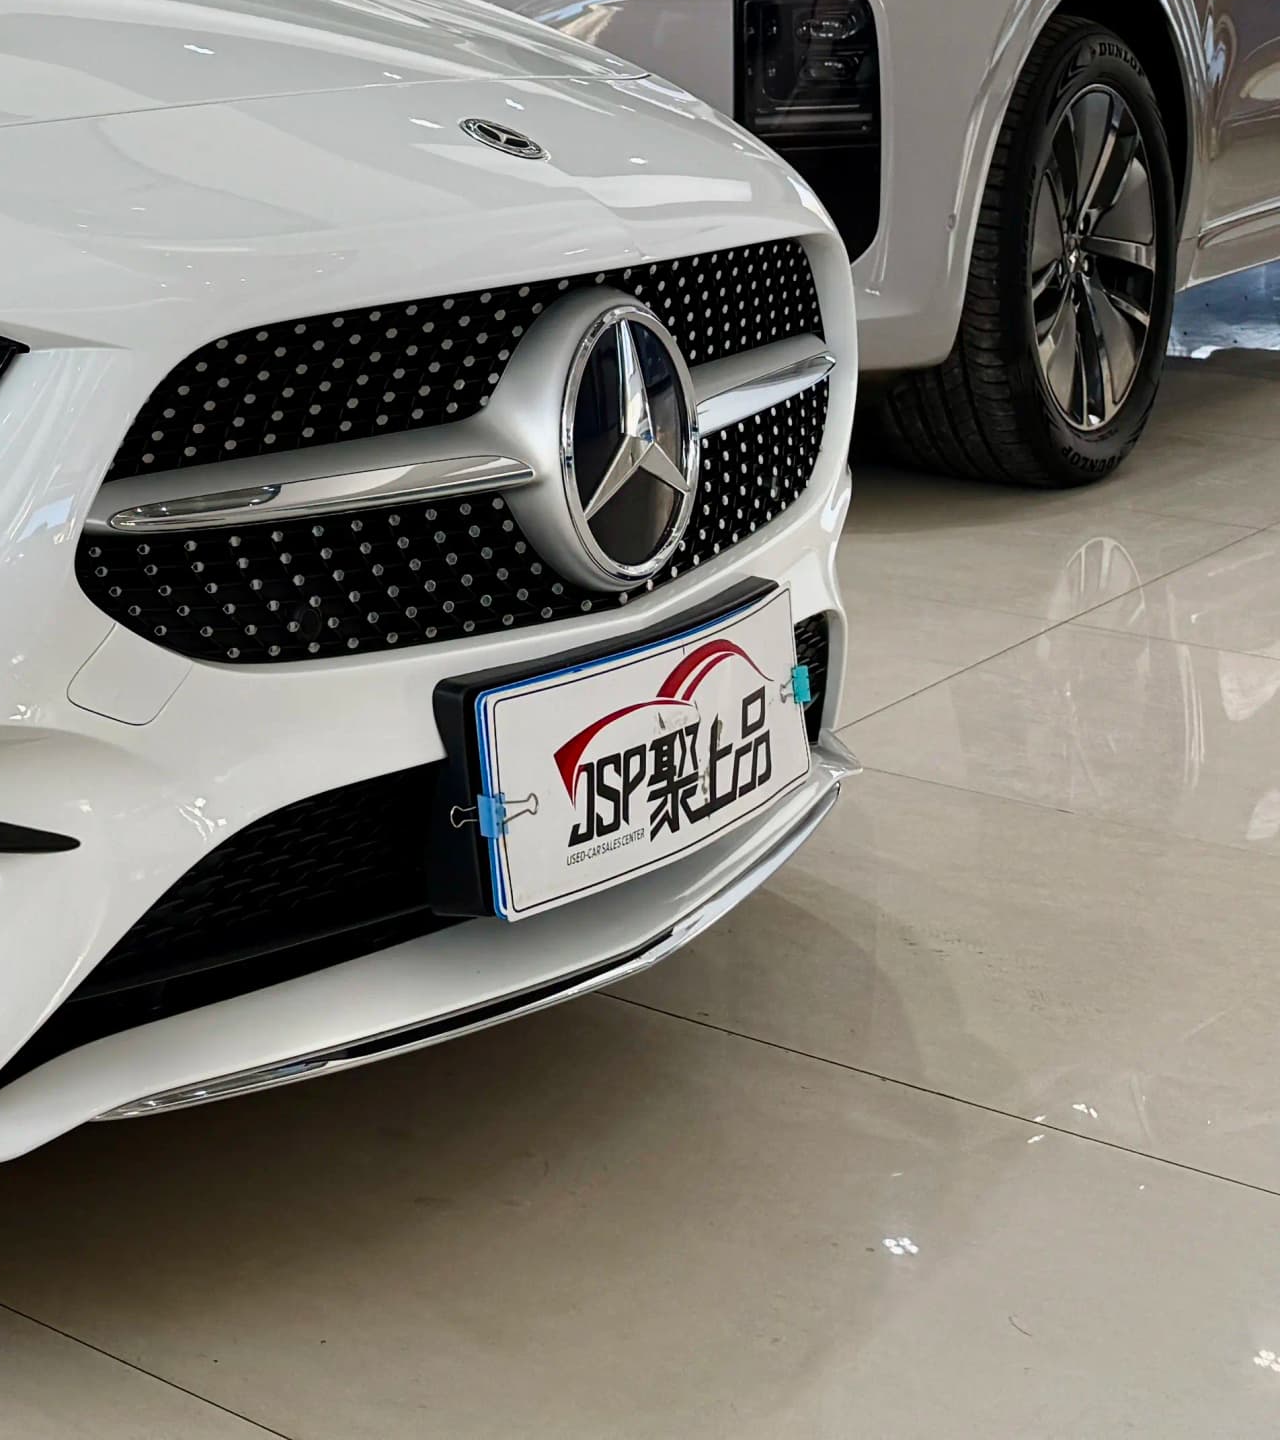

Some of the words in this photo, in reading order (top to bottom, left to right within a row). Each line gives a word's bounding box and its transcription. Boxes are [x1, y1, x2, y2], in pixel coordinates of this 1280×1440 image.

[567, 743, 647, 848] JSP
[566, 844, 601, 867] USED-CAR
[601, 836, 621, 855] SALES
[621, 827, 645, 847] CENTER
